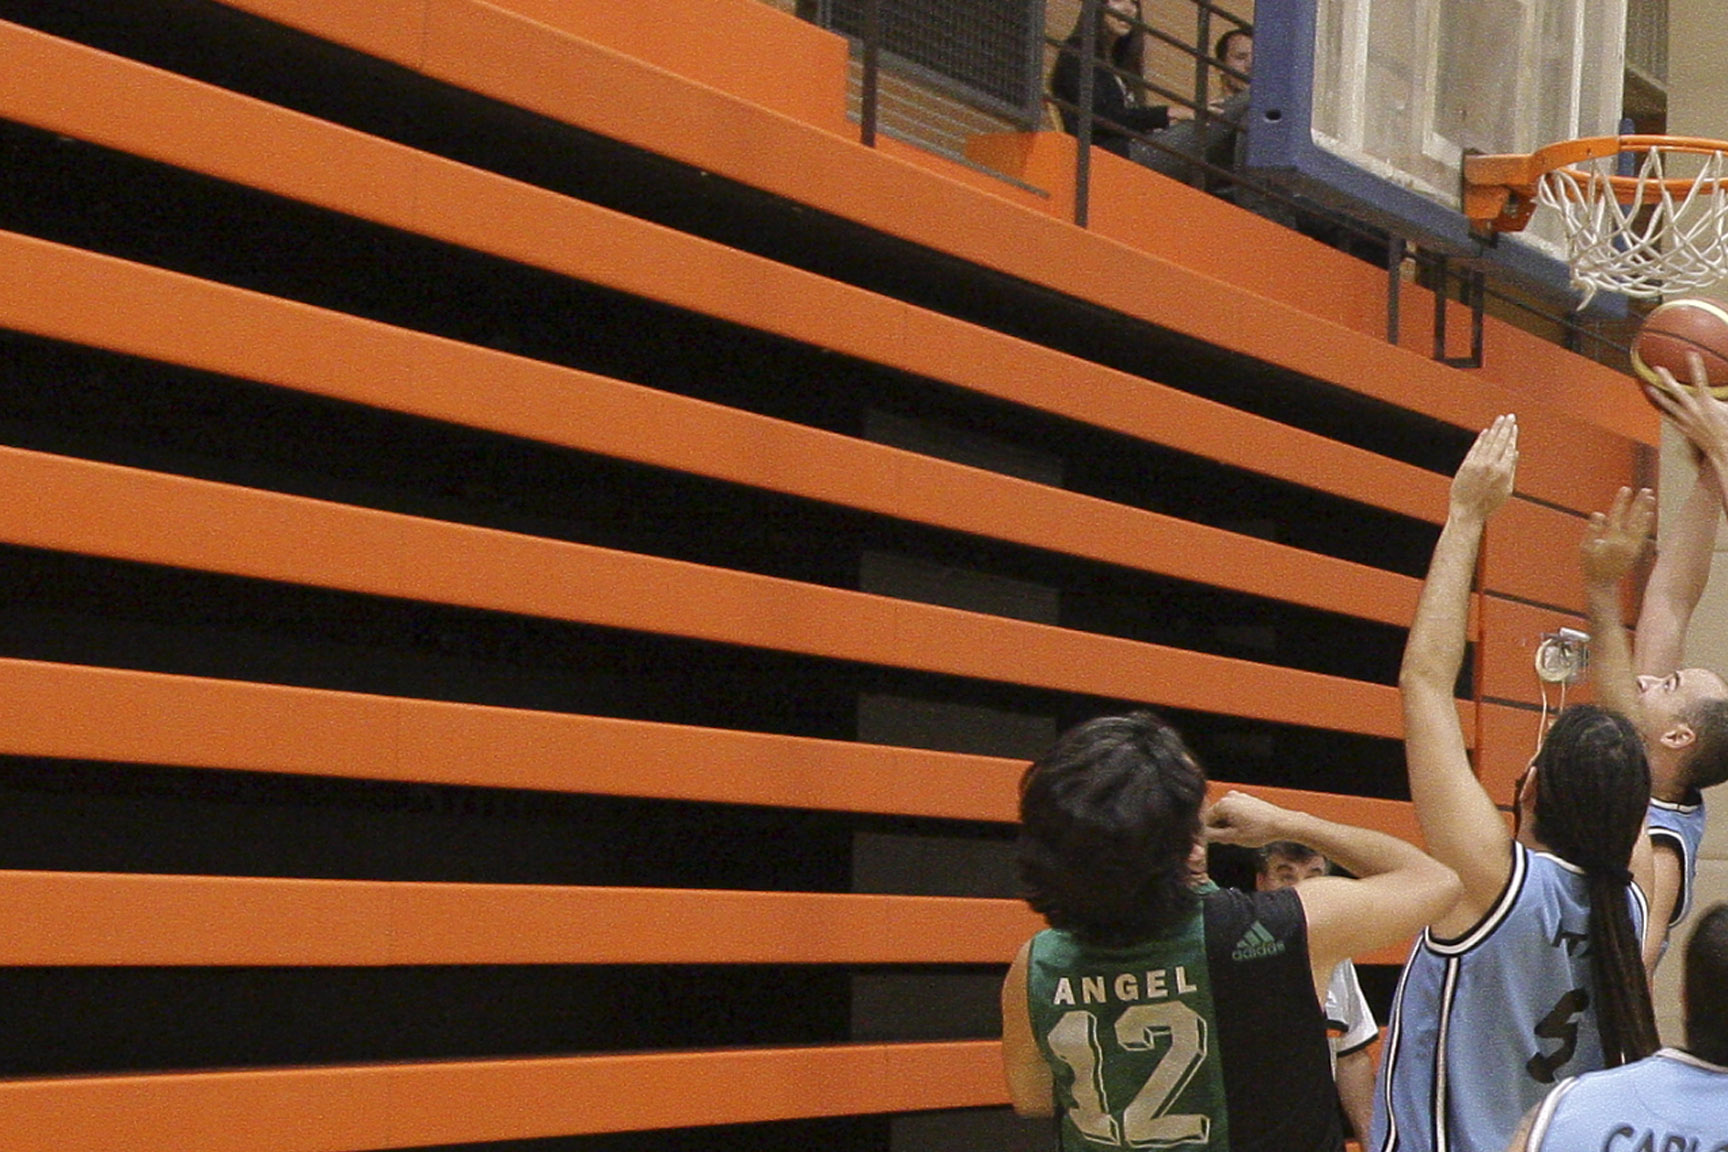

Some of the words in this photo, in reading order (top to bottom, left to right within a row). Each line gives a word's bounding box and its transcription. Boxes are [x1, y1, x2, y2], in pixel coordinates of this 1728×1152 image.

[1232, 940, 1286, 960] adidas
[1053, 966, 1198, 1005] ANGEL
[1047, 1001, 1211, 1148] 12
